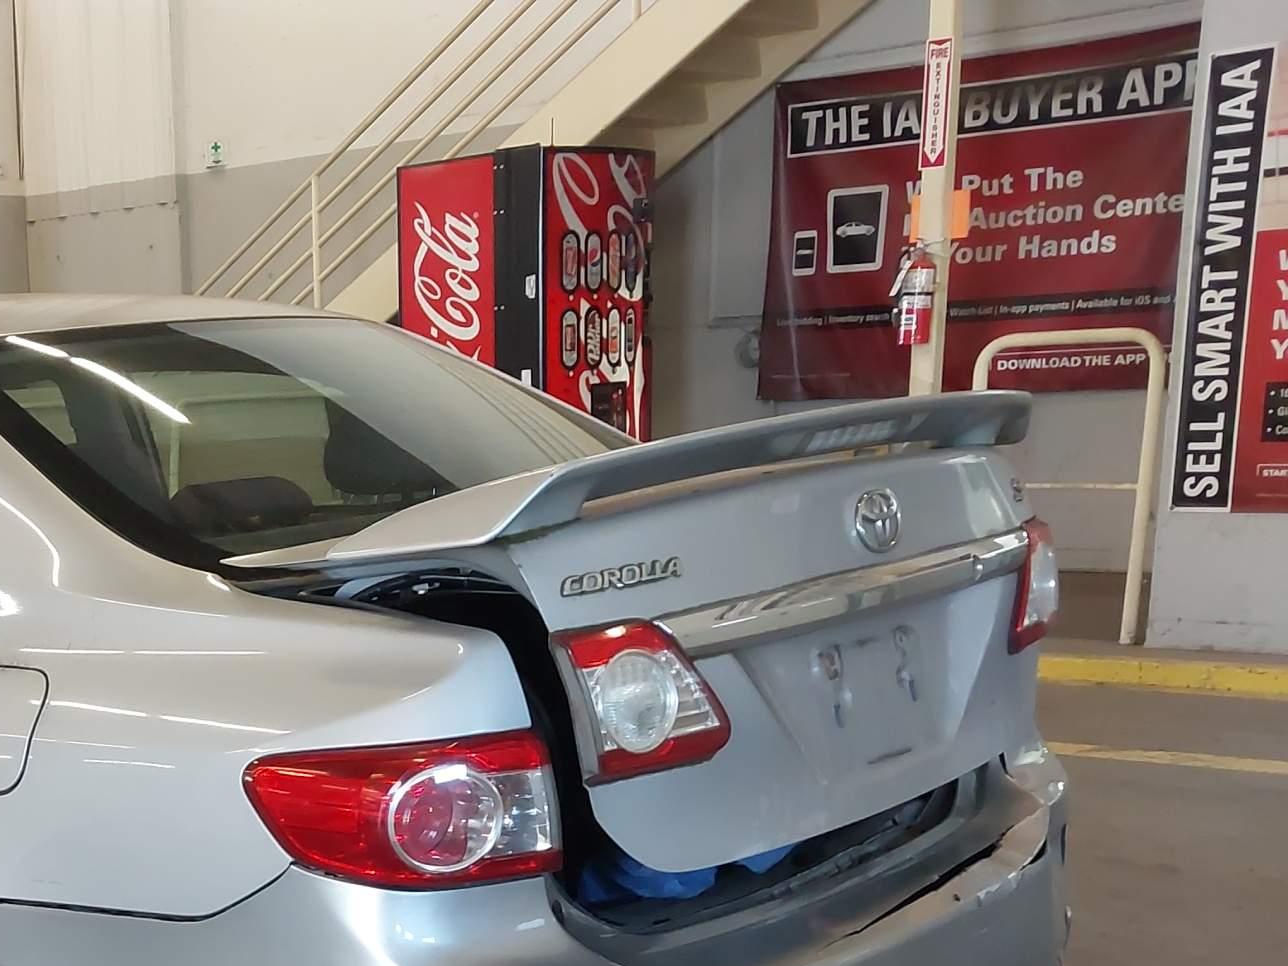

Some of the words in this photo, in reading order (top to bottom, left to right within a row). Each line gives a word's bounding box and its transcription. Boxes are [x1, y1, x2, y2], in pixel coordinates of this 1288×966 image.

[931, 47, 949, 59] FIRE
[801, 104, 870, 147] THE
[964, 75, 1104, 129] BUYER
[1215, 58, 1262, 135] IAA
[962, 173, 1013, 198] Put
[1024, 167, 1084, 192] The
[1204, 147, 1251, 256] WITH
[968, 201, 1083, 230] Auction
[1017, 230, 1117, 260] Hands
[1191, 265, 1239, 402] SMART
[997, 356, 1081, 371] DOWNLOAD
[1084, 354, 1111, 366] THE
[1114, 353, 1147, 366] APP
[1183, 412, 1225, 498] SELL
[560, 556, 682, 598] COROLLA
